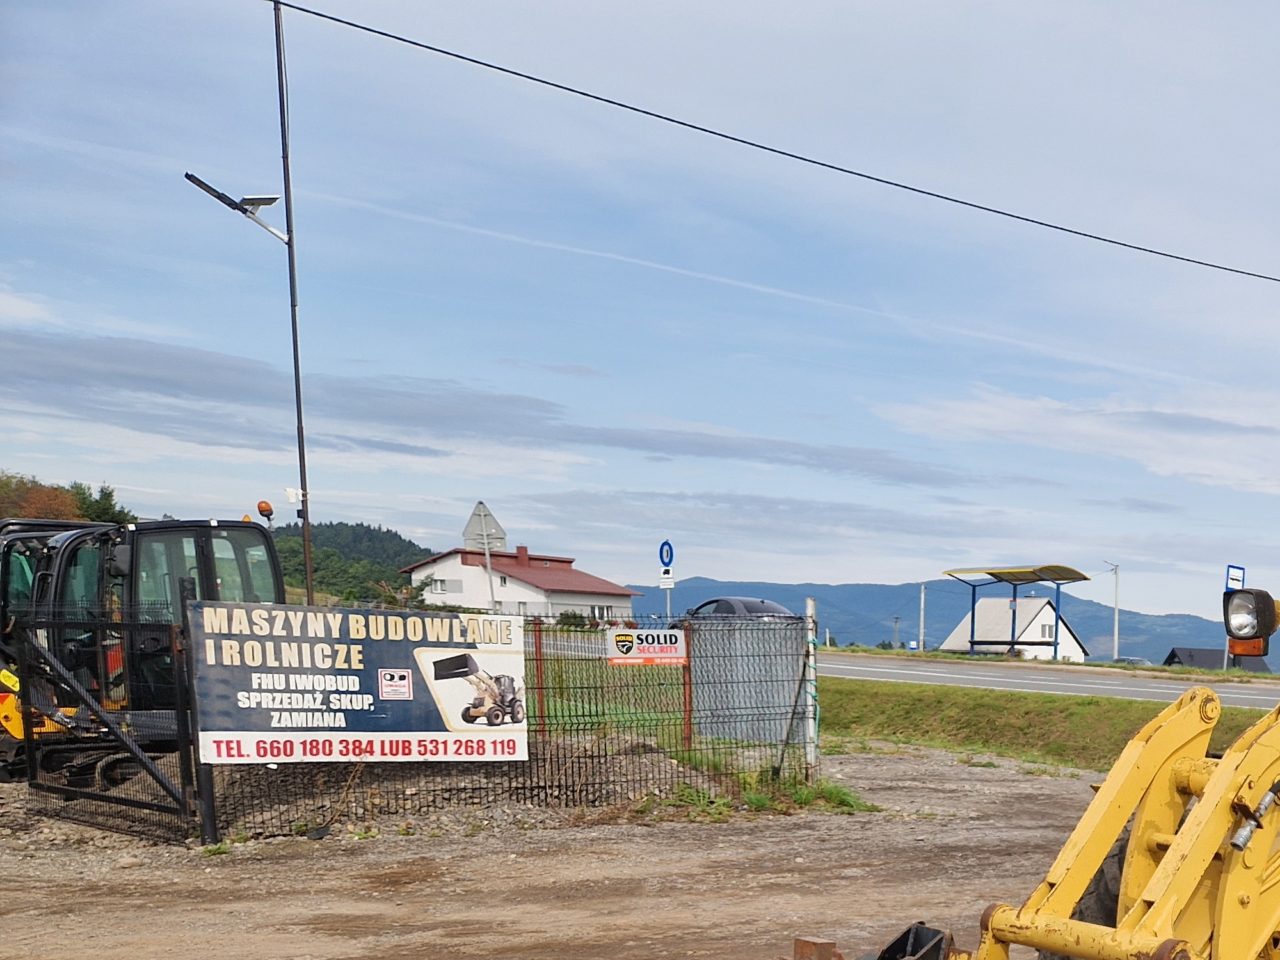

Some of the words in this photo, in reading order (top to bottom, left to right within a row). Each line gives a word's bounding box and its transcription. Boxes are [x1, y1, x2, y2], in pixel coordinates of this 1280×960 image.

[203, 607, 343, 639] MASZYNY
[351, 615, 512, 645] BUDOWLANE
[636, 633, 678, 645] SOLID
[205, 639, 216, 666] I
[222, 640, 365, 670] ROLNICZE
[636, 646, 678, 654] SECURITY
[251, 673, 287, 690] FHU
[289, 674, 360, 691] IWOBUD
[237, 690, 326, 710] SPRZEDAŻ,
[329, 695, 375, 711] SKUP,
[270, 712, 346, 728] ZAMIANA
[212, 740, 250, 758] TEL.
[256, 740, 294, 758] 660
[299, 740, 334, 757] 180
[338, 740, 375, 757] 384
[380, 740, 412, 756] LUB
[417, 739, 448, 756] 531
[453, 739, 486, 756] 268
[491, 739, 516, 756] 119
